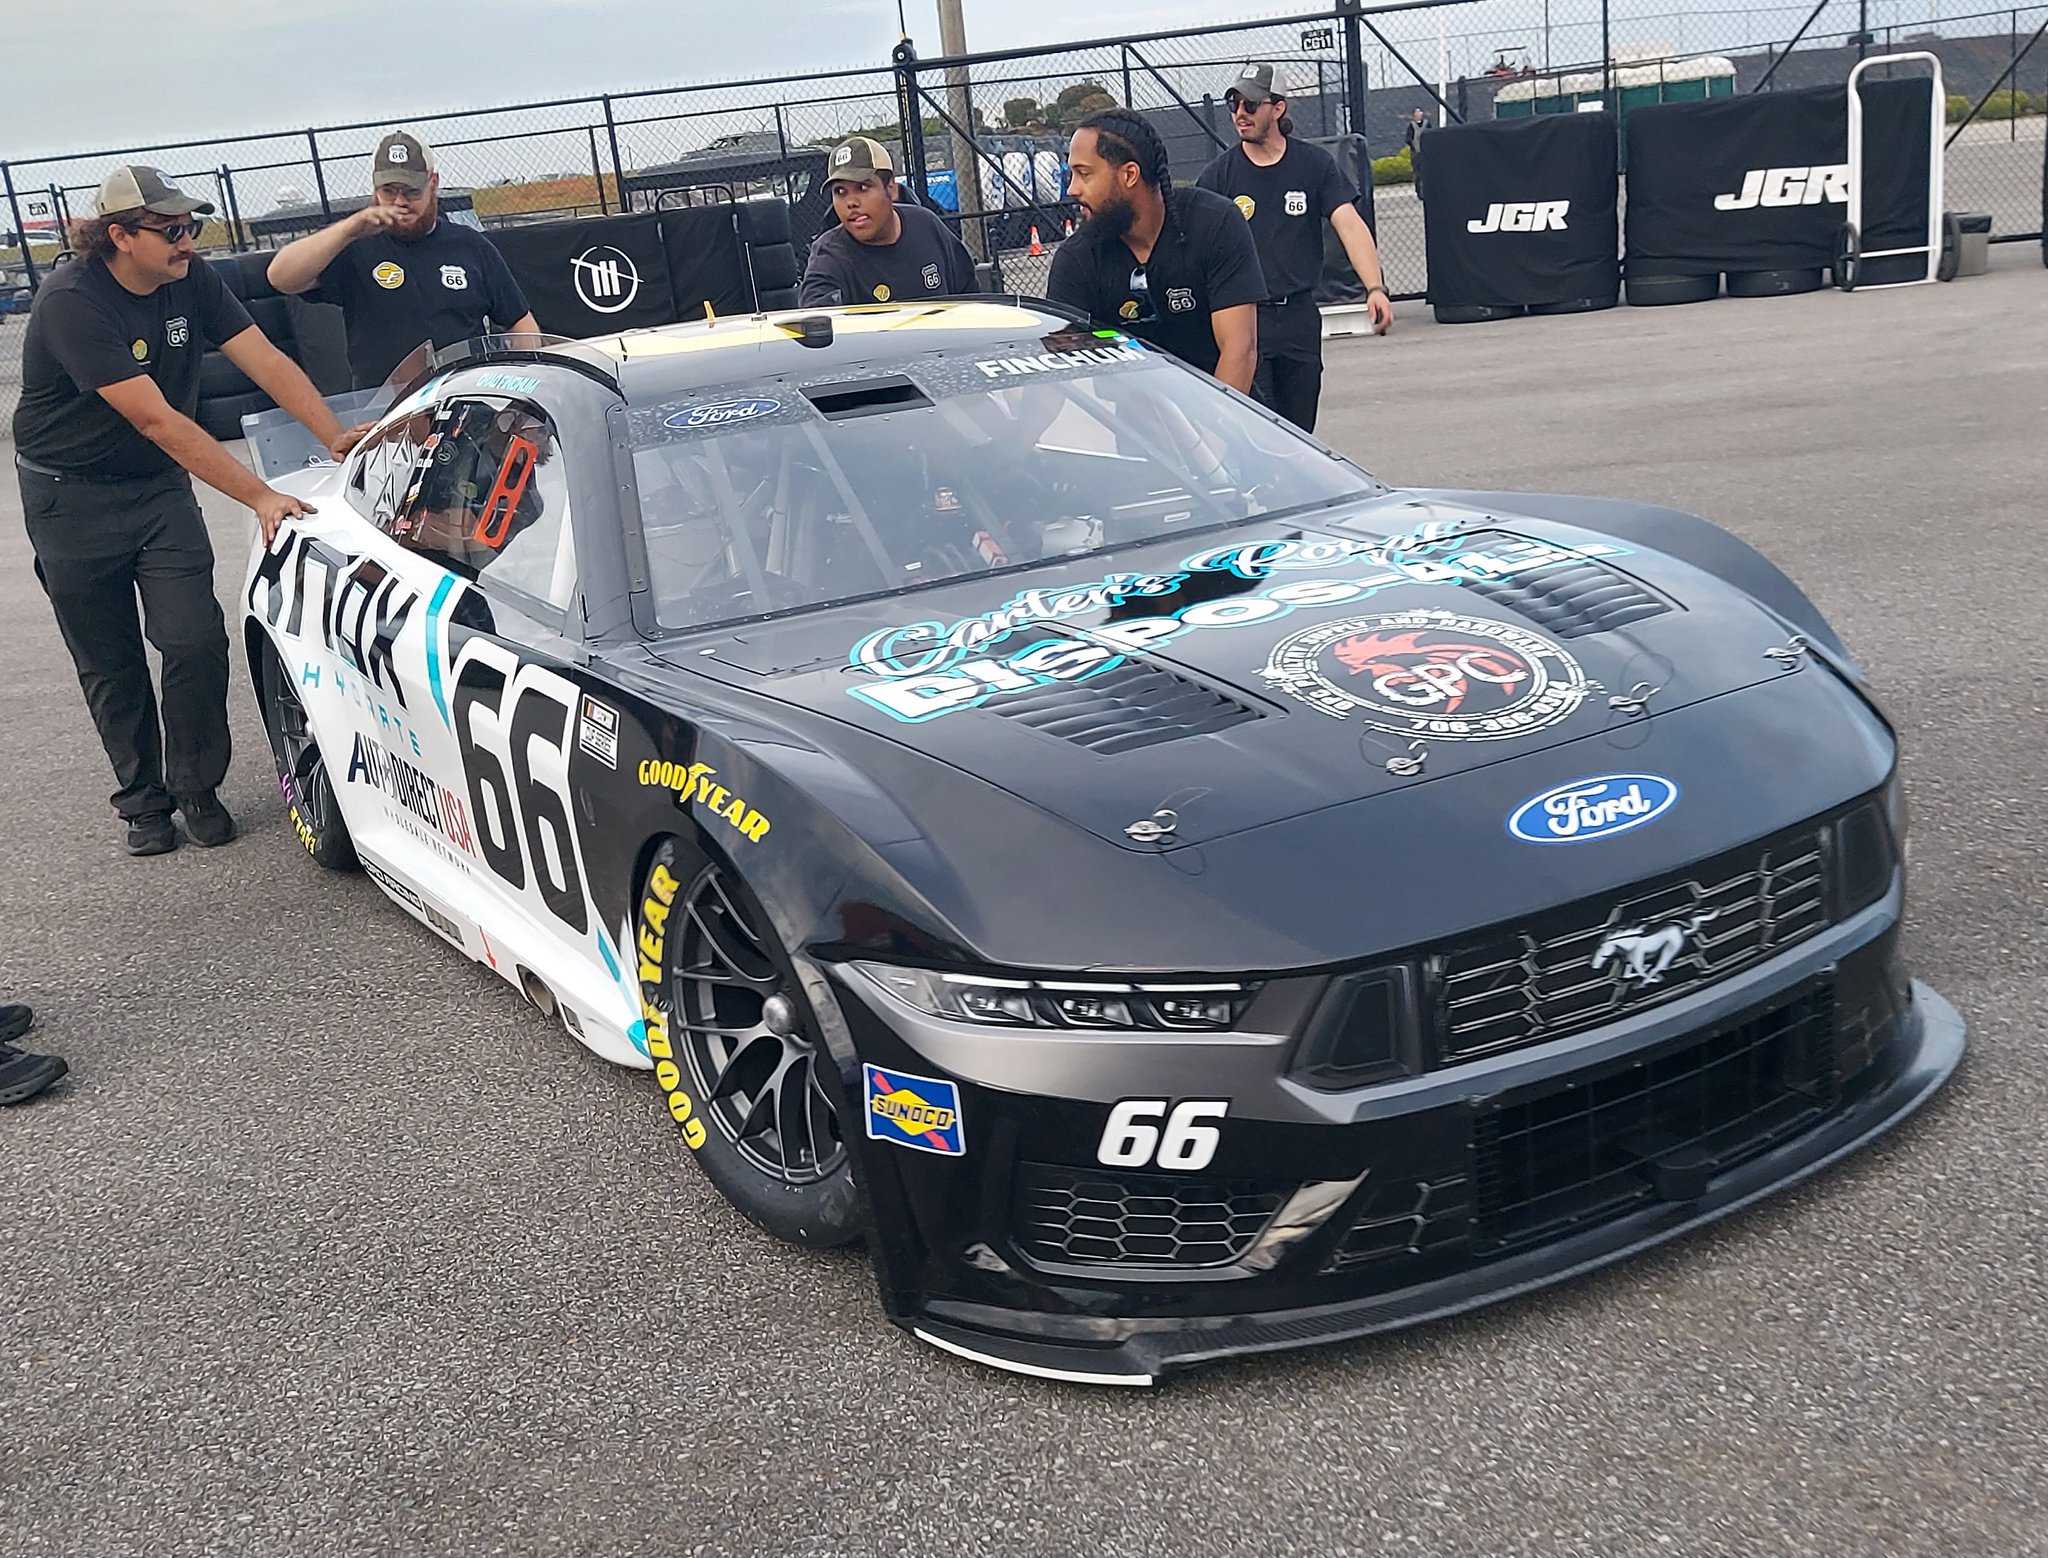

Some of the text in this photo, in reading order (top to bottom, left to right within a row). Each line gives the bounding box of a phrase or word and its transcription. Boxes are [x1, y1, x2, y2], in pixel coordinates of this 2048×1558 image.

[1714, 164, 1849, 210] JGR
[1288, 201, 1304, 212] 66
[1467, 200, 1570, 233] JGR
[445, 275, 464, 286] 66
[926, 273, 939, 286] 66
[1171, 297, 1192, 311] 66
[170, 328, 187, 344] 66
[975, 344, 1147, 378] FINCHUM
[687, 402, 759, 426] Ford
[851, 573, 1186, 676] Carter's
[1300, 620, 1369, 645] SUPPLY
[1379, 617, 1429, 626] AND
[1439, 618, 1557, 659] HARDWARE
[1372, 651, 1529, 706] GPC
[451, 656, 589, 936] 66
[638, 759, 771, 843] GOODYEAR
[1543, 783, 1651, 837] Ford
[639, 863, 707, 1150] GOODYEAR
[875, 1096, 951, 1128] SUNOCO
[1097, 1100, 1229, 1171] 66
